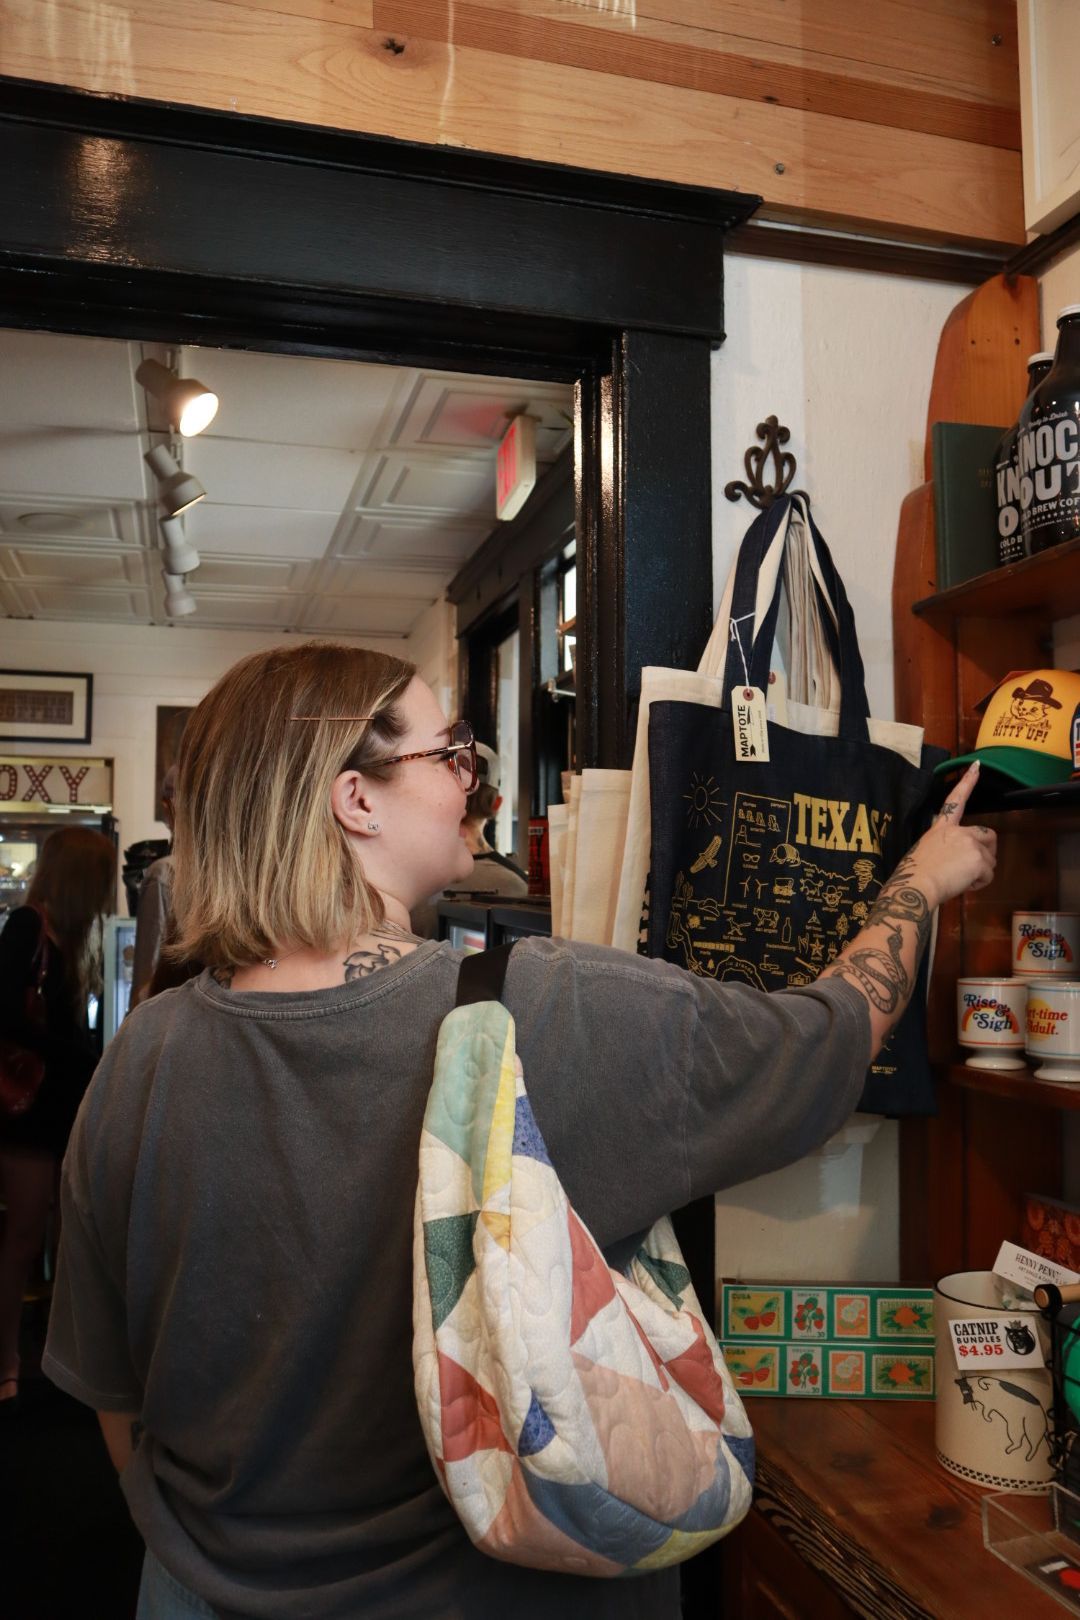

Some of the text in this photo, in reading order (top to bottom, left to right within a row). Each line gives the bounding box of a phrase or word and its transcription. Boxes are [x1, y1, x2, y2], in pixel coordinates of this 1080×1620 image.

[1032, 501, 1057, 516] BREW
[1059, 497, 1080, 508] COF
[737, 703, 750, 758] MAPTOTE
[993, 724, 1048, 743] KITTY UP!
[1019, 924, 1052, 941] Rise
[1028, 942, 1066, 960] Sigh
[964, 994, 997, 1010] Rise
[973, 1013, 1012, 1032] Sigh
[954, 1322, 999, 1336] CATNIP
[956, 1335, 1002, 1344] BUNDLES
[958, 1344, 1004, 1357] $4.95
